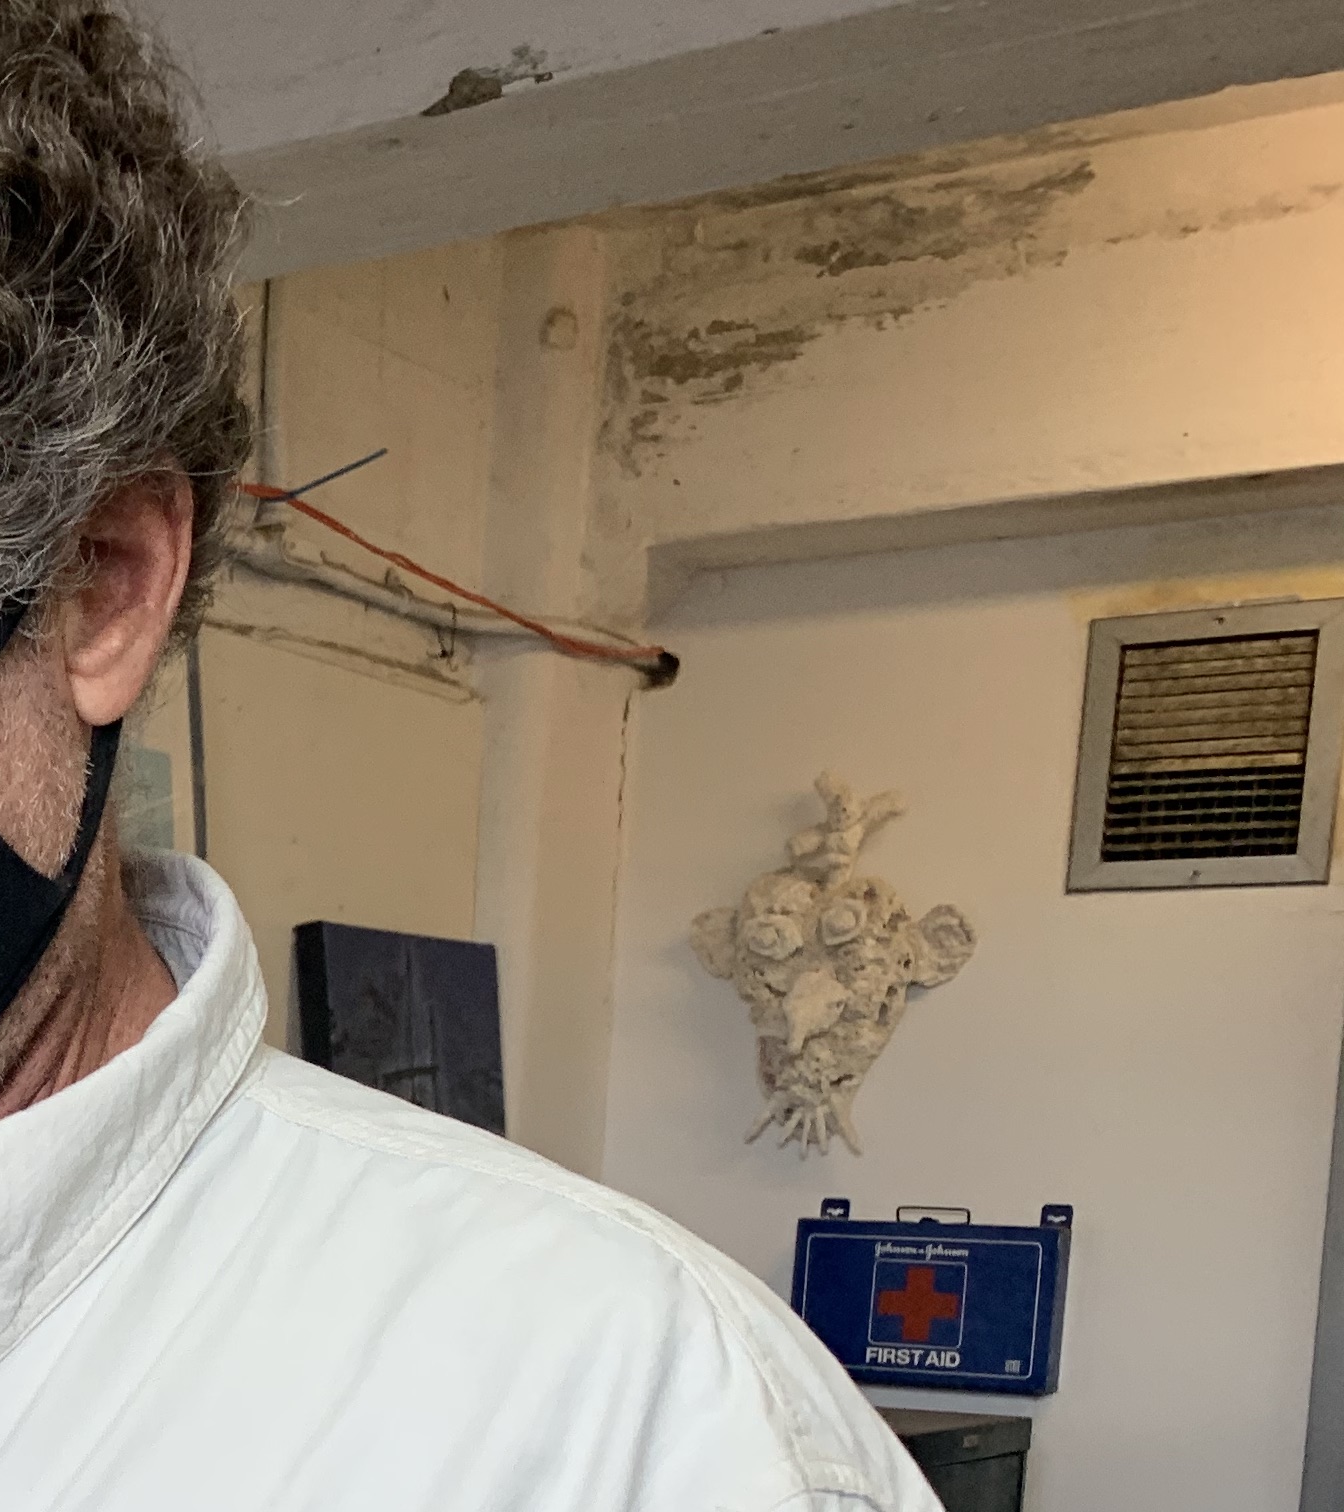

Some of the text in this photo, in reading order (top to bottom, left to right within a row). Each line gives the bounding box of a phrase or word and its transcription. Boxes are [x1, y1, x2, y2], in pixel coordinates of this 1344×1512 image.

[875, 1241, 917, 1257] Johnson
[925, 1243, 968, 1261] Johnson
[865, 1346, 961, 1368] FIRST AID
